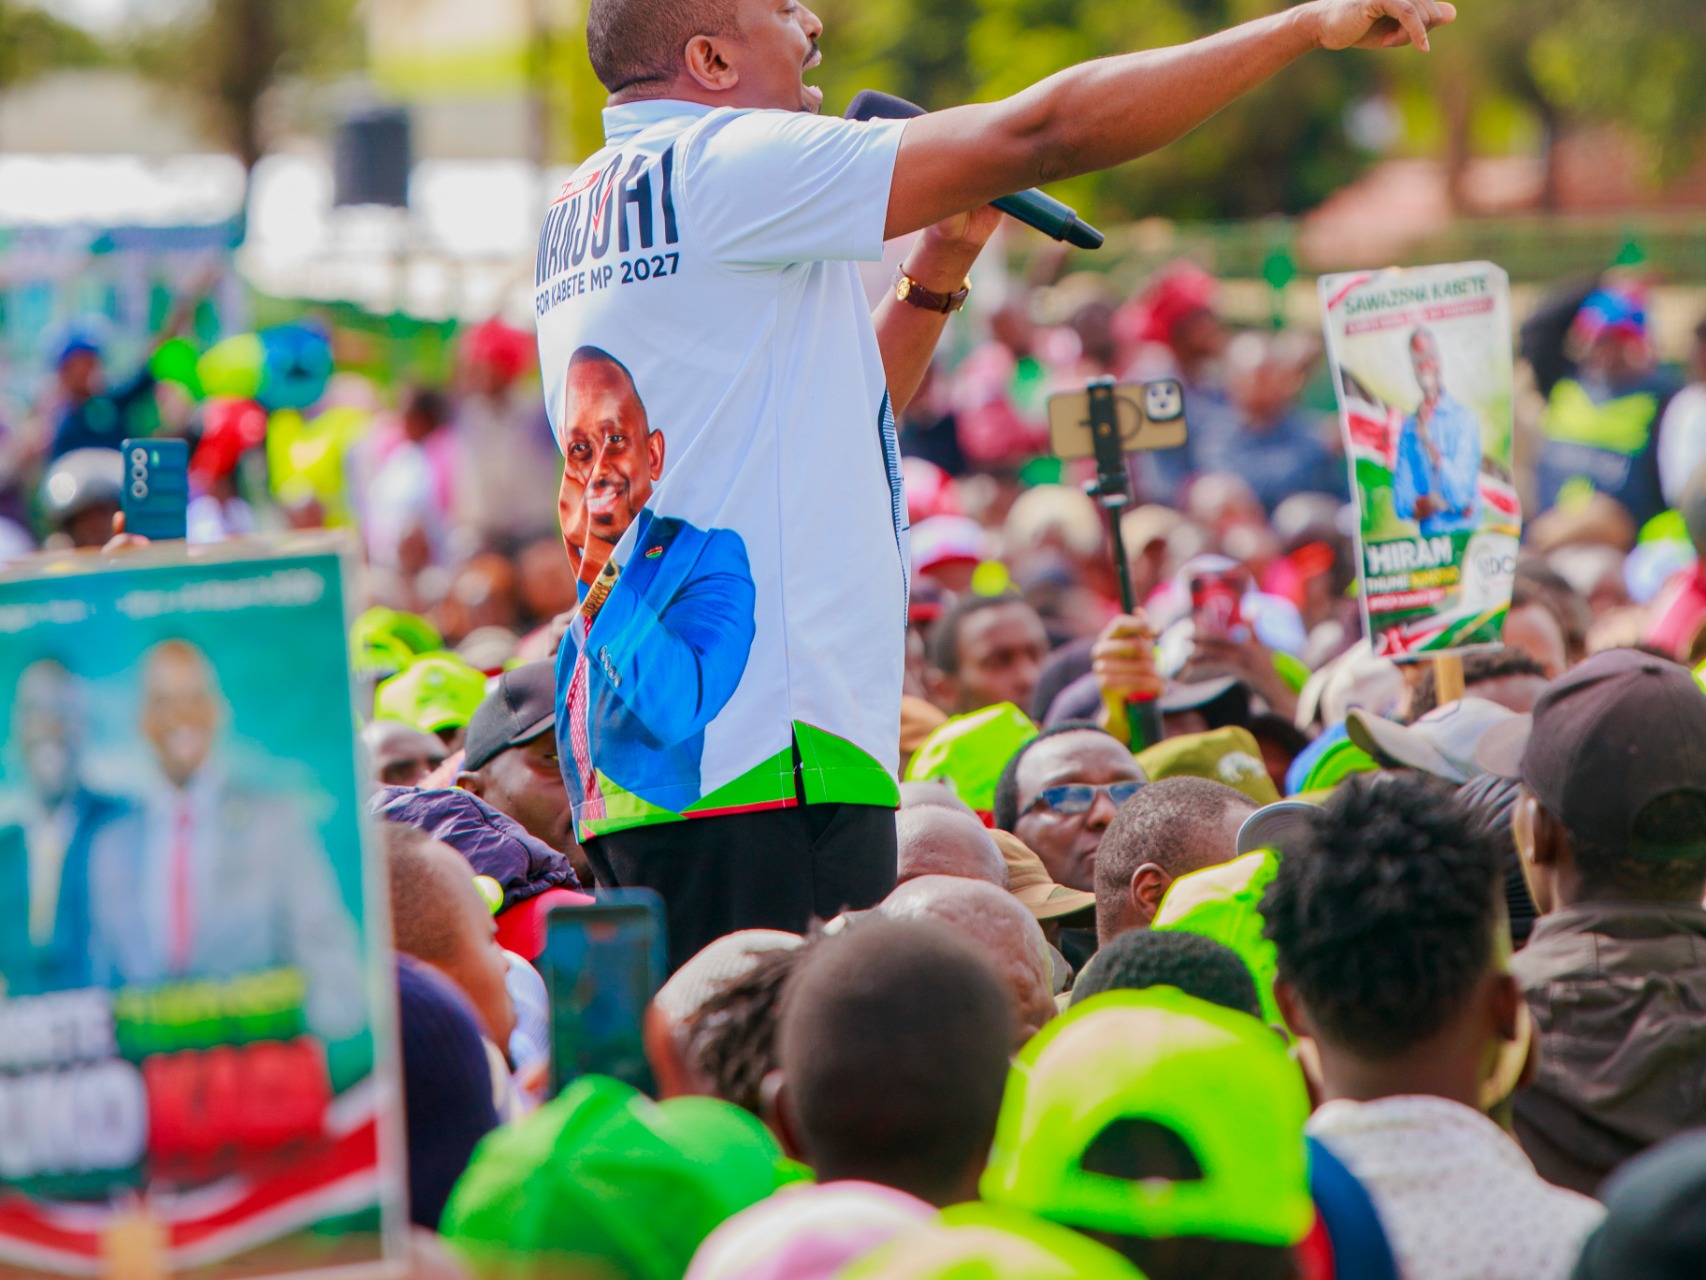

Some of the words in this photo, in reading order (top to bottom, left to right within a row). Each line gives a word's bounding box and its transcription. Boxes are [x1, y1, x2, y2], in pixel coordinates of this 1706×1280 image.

[536, 143, 679, 288] WANJOHI
[536, 294, 550, 319] FOR
[551, 272, 586, 308] KABETE
[590, 264, 613, 291] MP
[619, 252, 680, 284] 2027
[1432, 275, 1487, 300] KABETE
[1367, 535, 1453, 576] HIRAM
